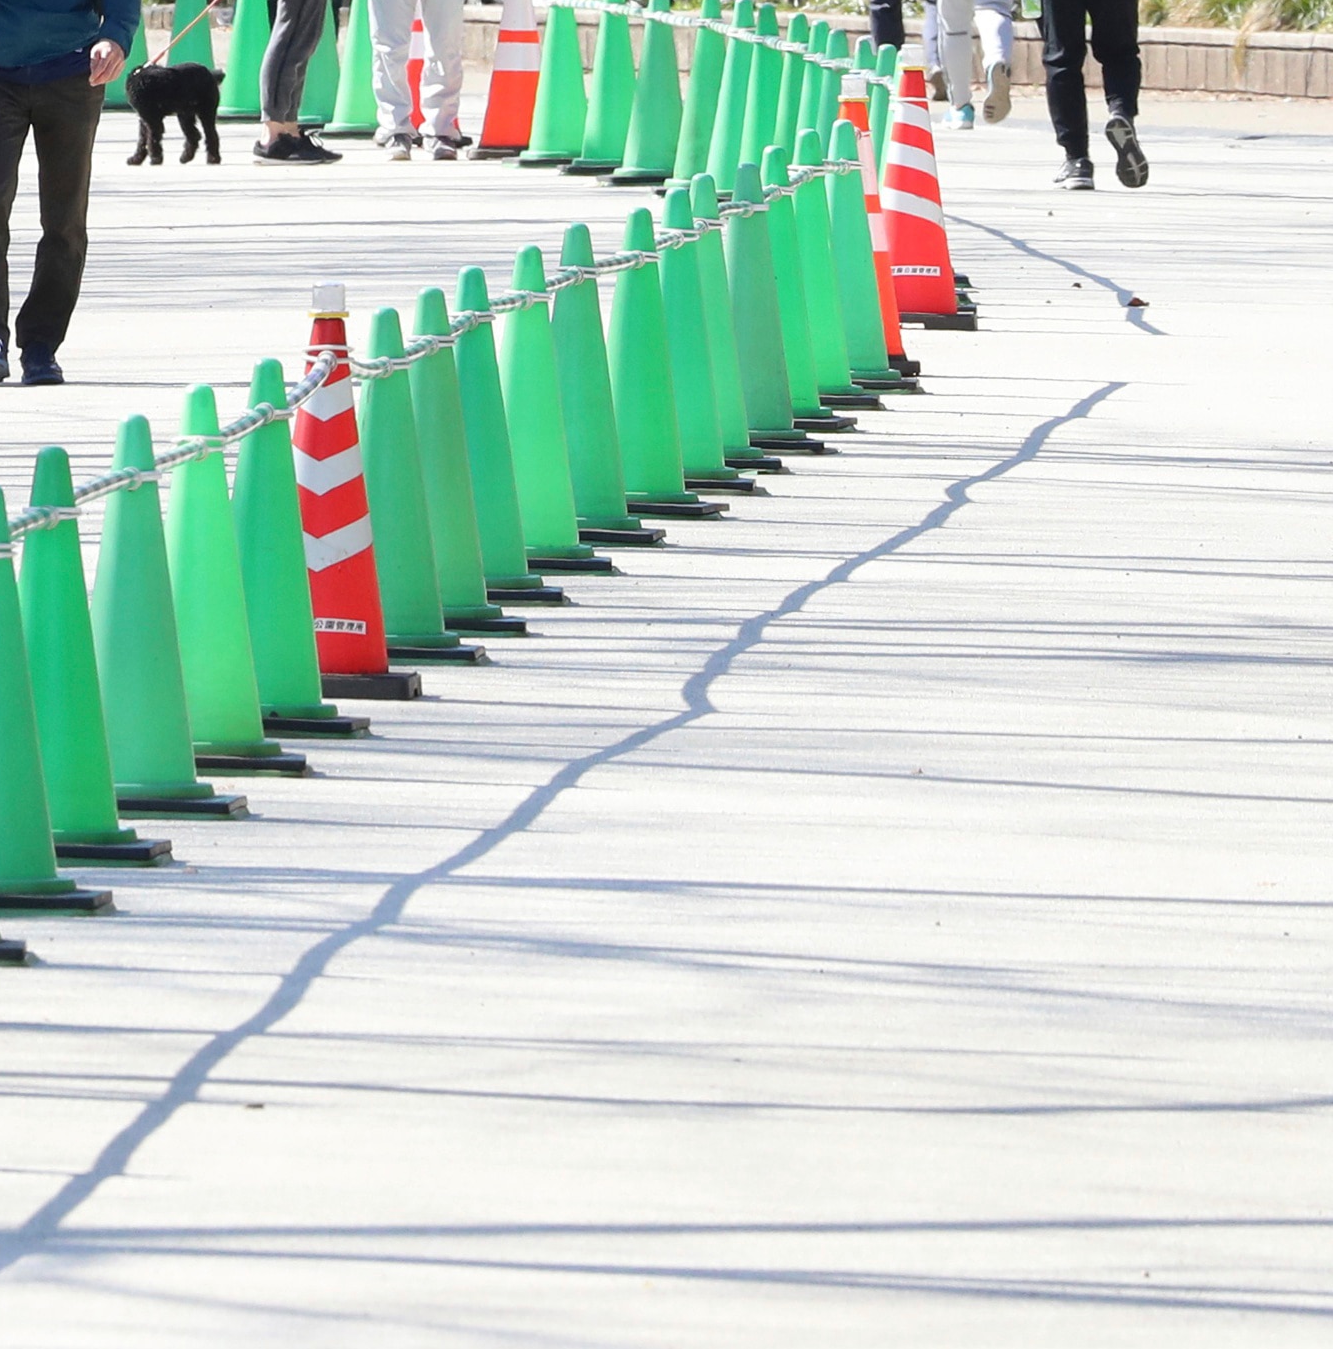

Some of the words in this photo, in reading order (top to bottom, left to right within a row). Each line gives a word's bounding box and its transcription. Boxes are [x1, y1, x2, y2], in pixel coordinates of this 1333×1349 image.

[314, 619, 364, 632] 公園管理所
